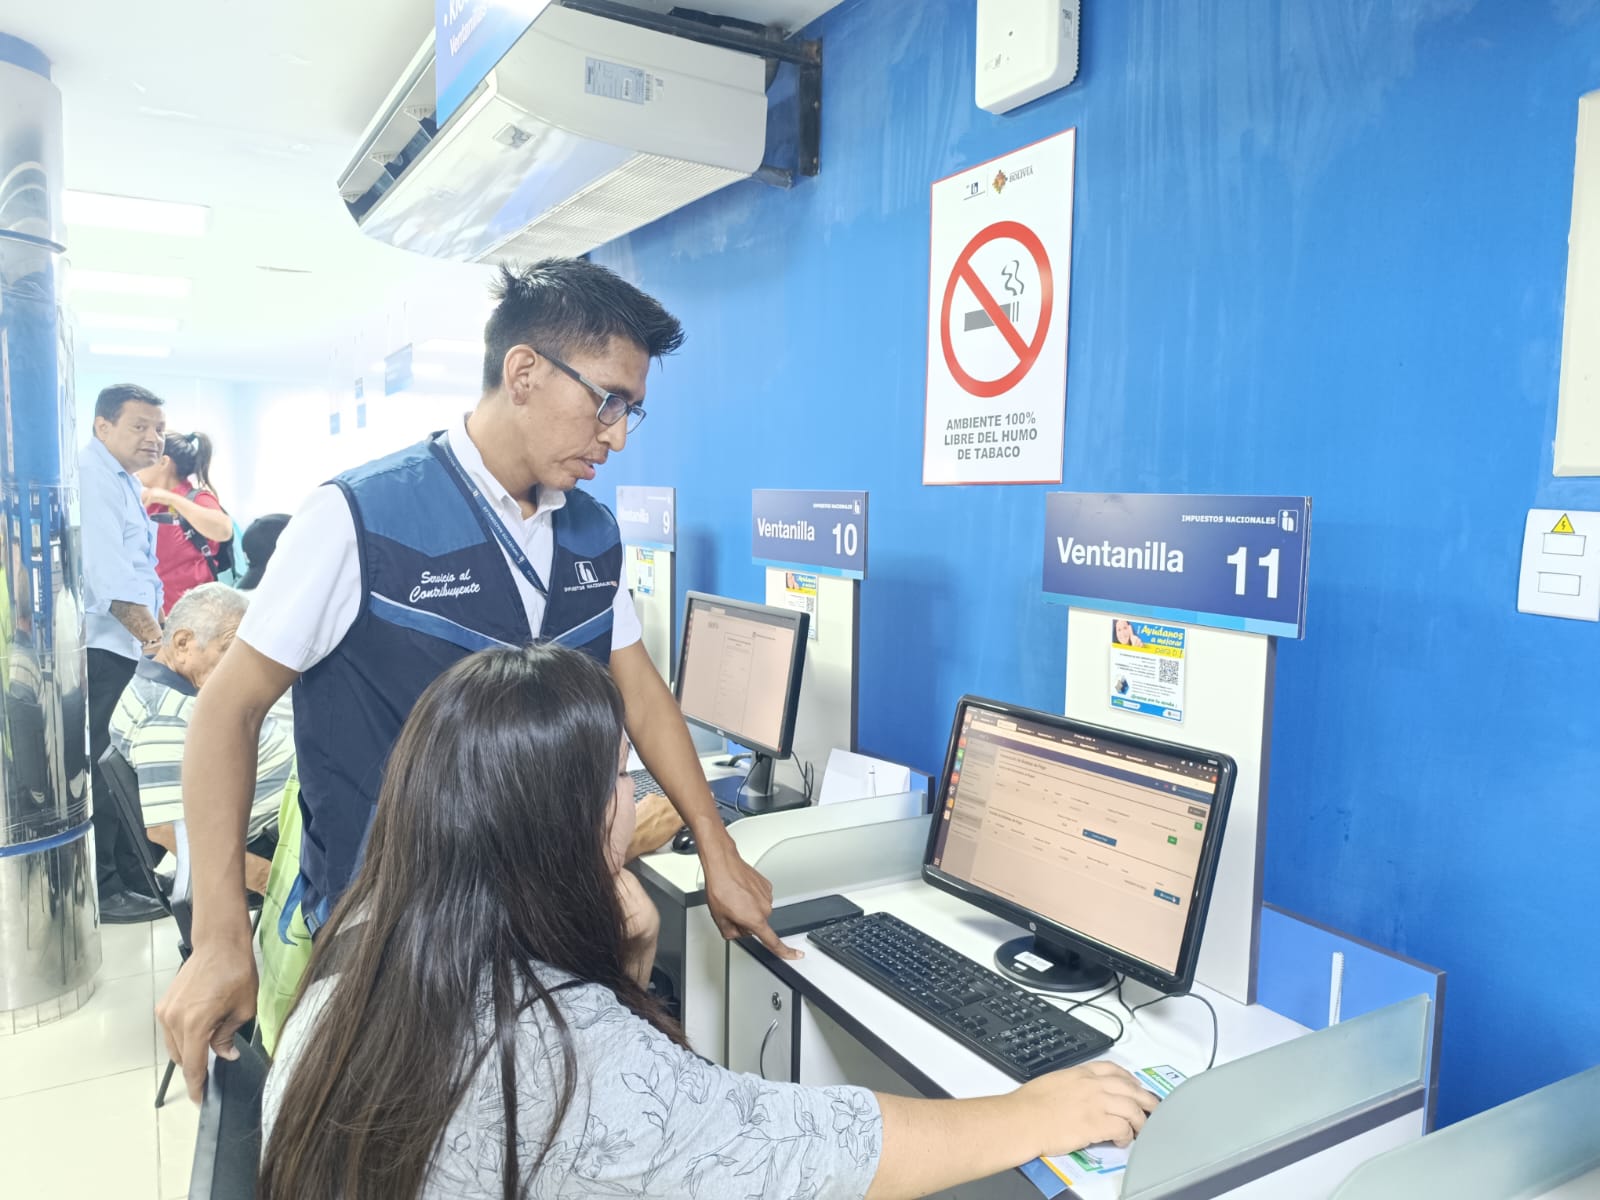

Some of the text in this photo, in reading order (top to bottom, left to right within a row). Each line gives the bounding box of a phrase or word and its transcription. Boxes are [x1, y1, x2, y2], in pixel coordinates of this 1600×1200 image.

[946, 411, 1036, 430] AMBIENTE 100%
[944, 428, 1038, 446] LIBRE DEL HUMO
[957, 446, 1021, 460] DE TABACO
[663, 510, 670, 535] 9
[1181, 514, 1224, 523] IMPUESTOS
[1225, 515, 1276, 525] NACIONALES
[757, 518, 858, 556] Ventanilla 10
[421, 568, 471, 584] Servicio al
[1057, 536, 1280, 599] Ventanilla 11
[409, 582, 480, 603] Contribuyente
